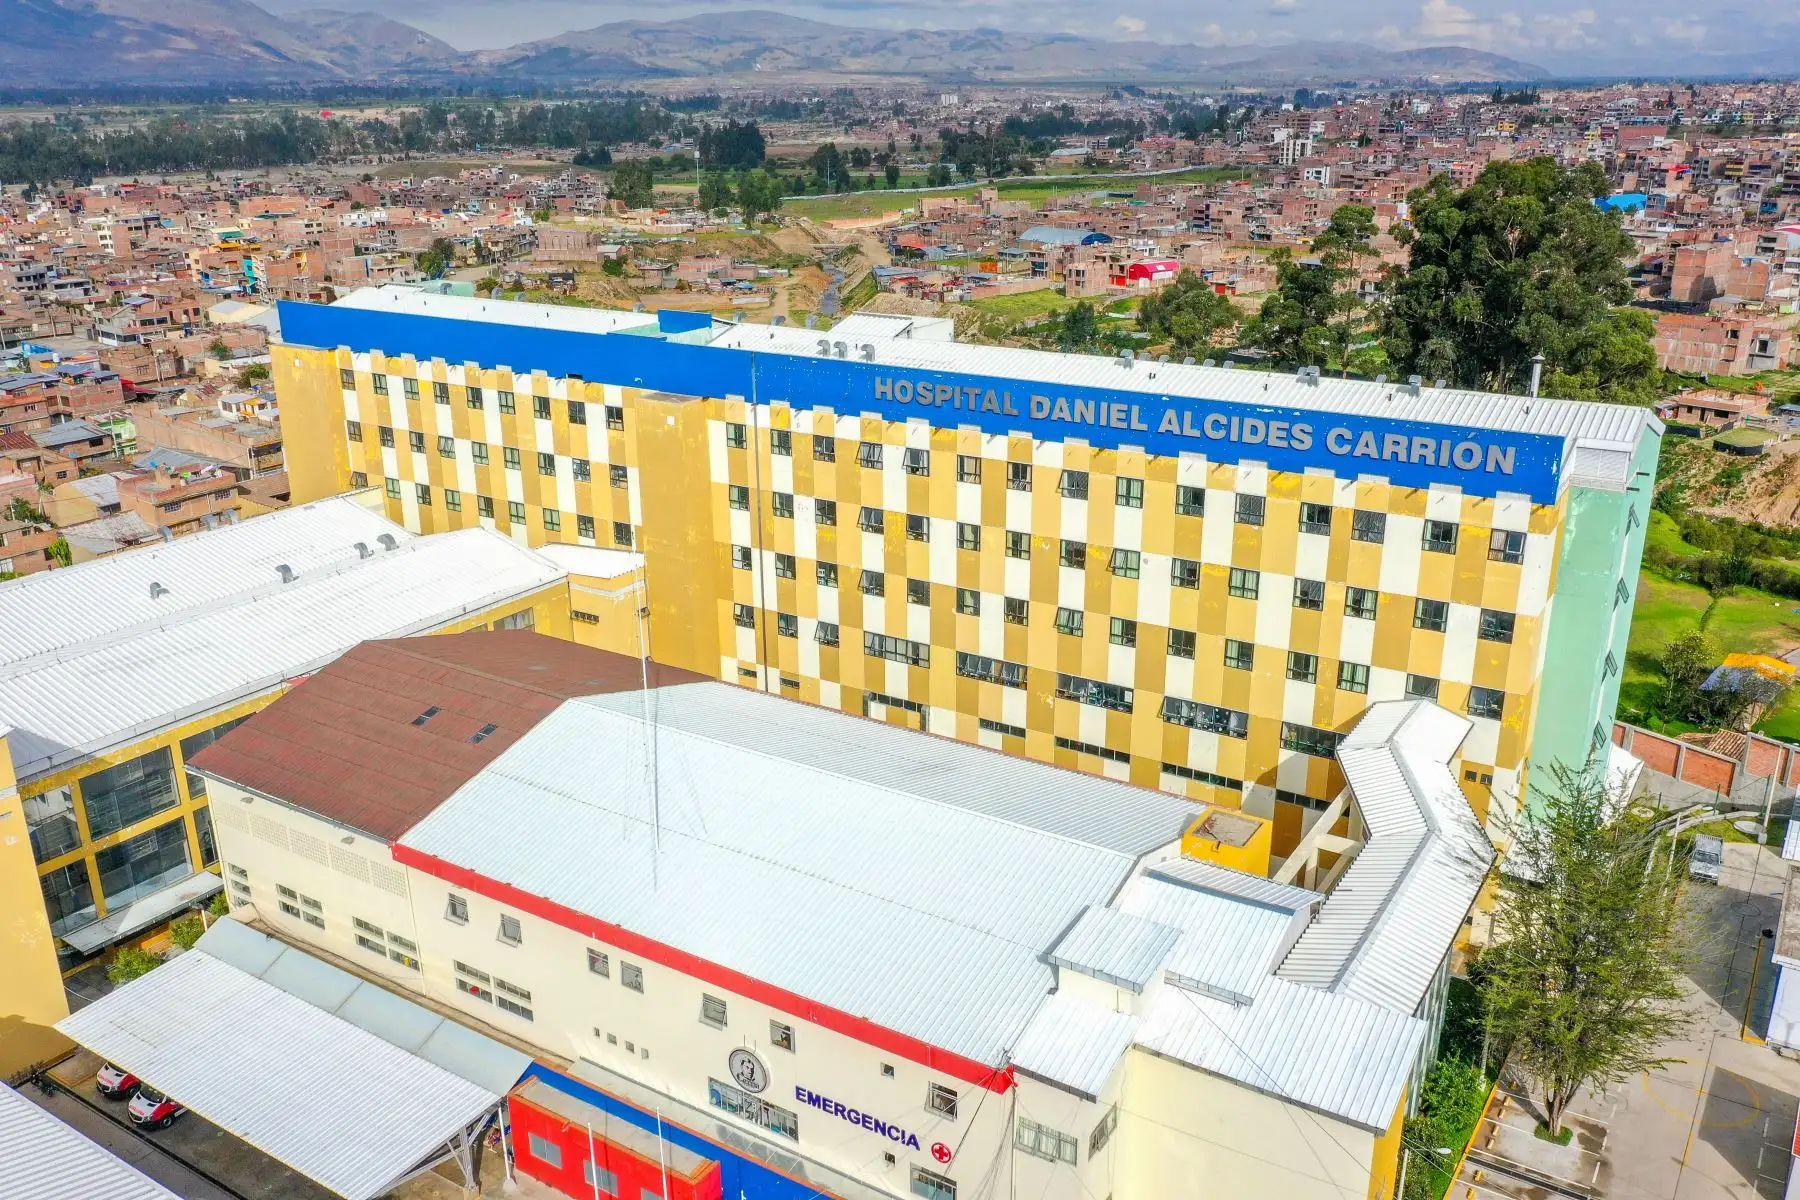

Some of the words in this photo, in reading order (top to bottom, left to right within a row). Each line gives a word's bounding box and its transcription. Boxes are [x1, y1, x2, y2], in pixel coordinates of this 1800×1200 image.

[873, 376, 1019, 416] HOSPITAL
[1028, 394, 1148, 431] DANIEL
[1157, 408, 1313, 451] ALCIDES
[1325, 427, 1516, 475] CARRIÓN
[795, 1085, 921, 1151] EMERGENCIA
